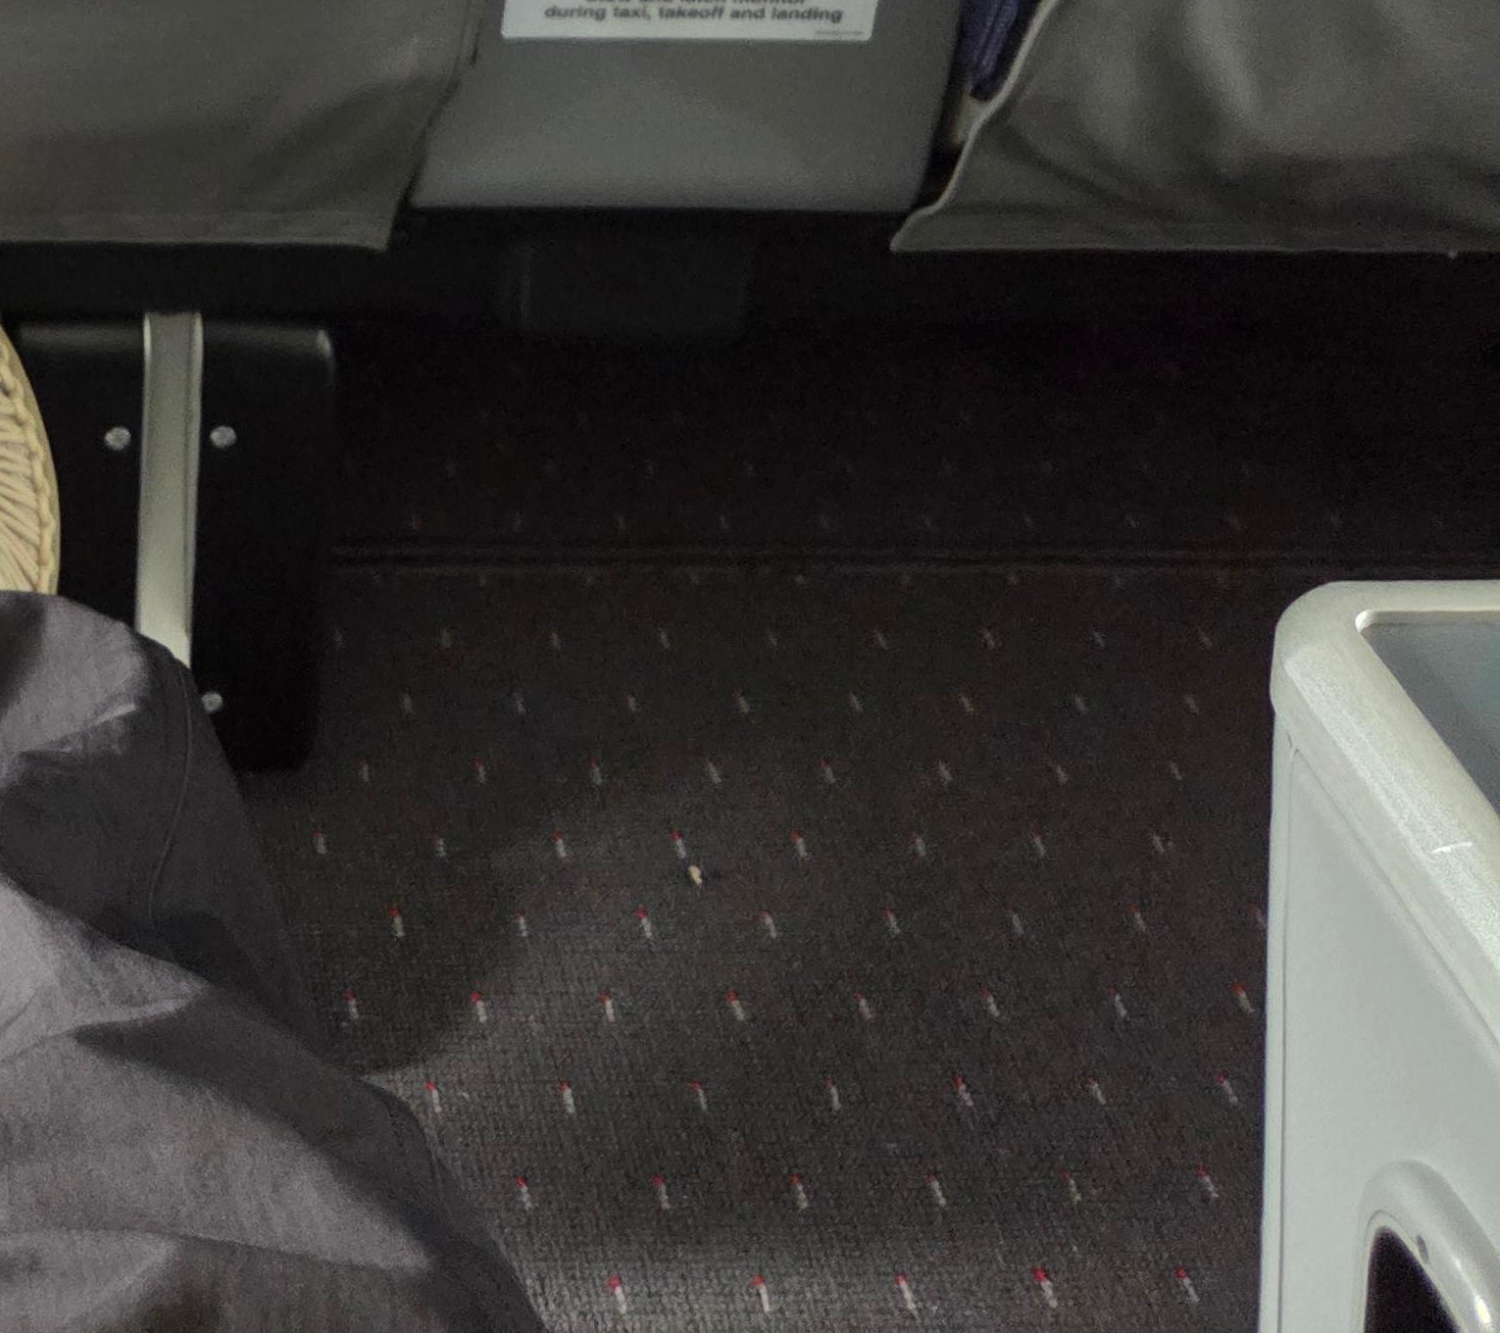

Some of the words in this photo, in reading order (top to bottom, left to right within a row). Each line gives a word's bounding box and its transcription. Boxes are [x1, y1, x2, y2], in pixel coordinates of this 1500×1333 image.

[544, 5, 607, 21] during
[612, 5, 651, 21] taxi,
[658, 6, 725, 20] takeoff
[729, 6, 766, 21] and
[771, 7, 844, 23] landing
